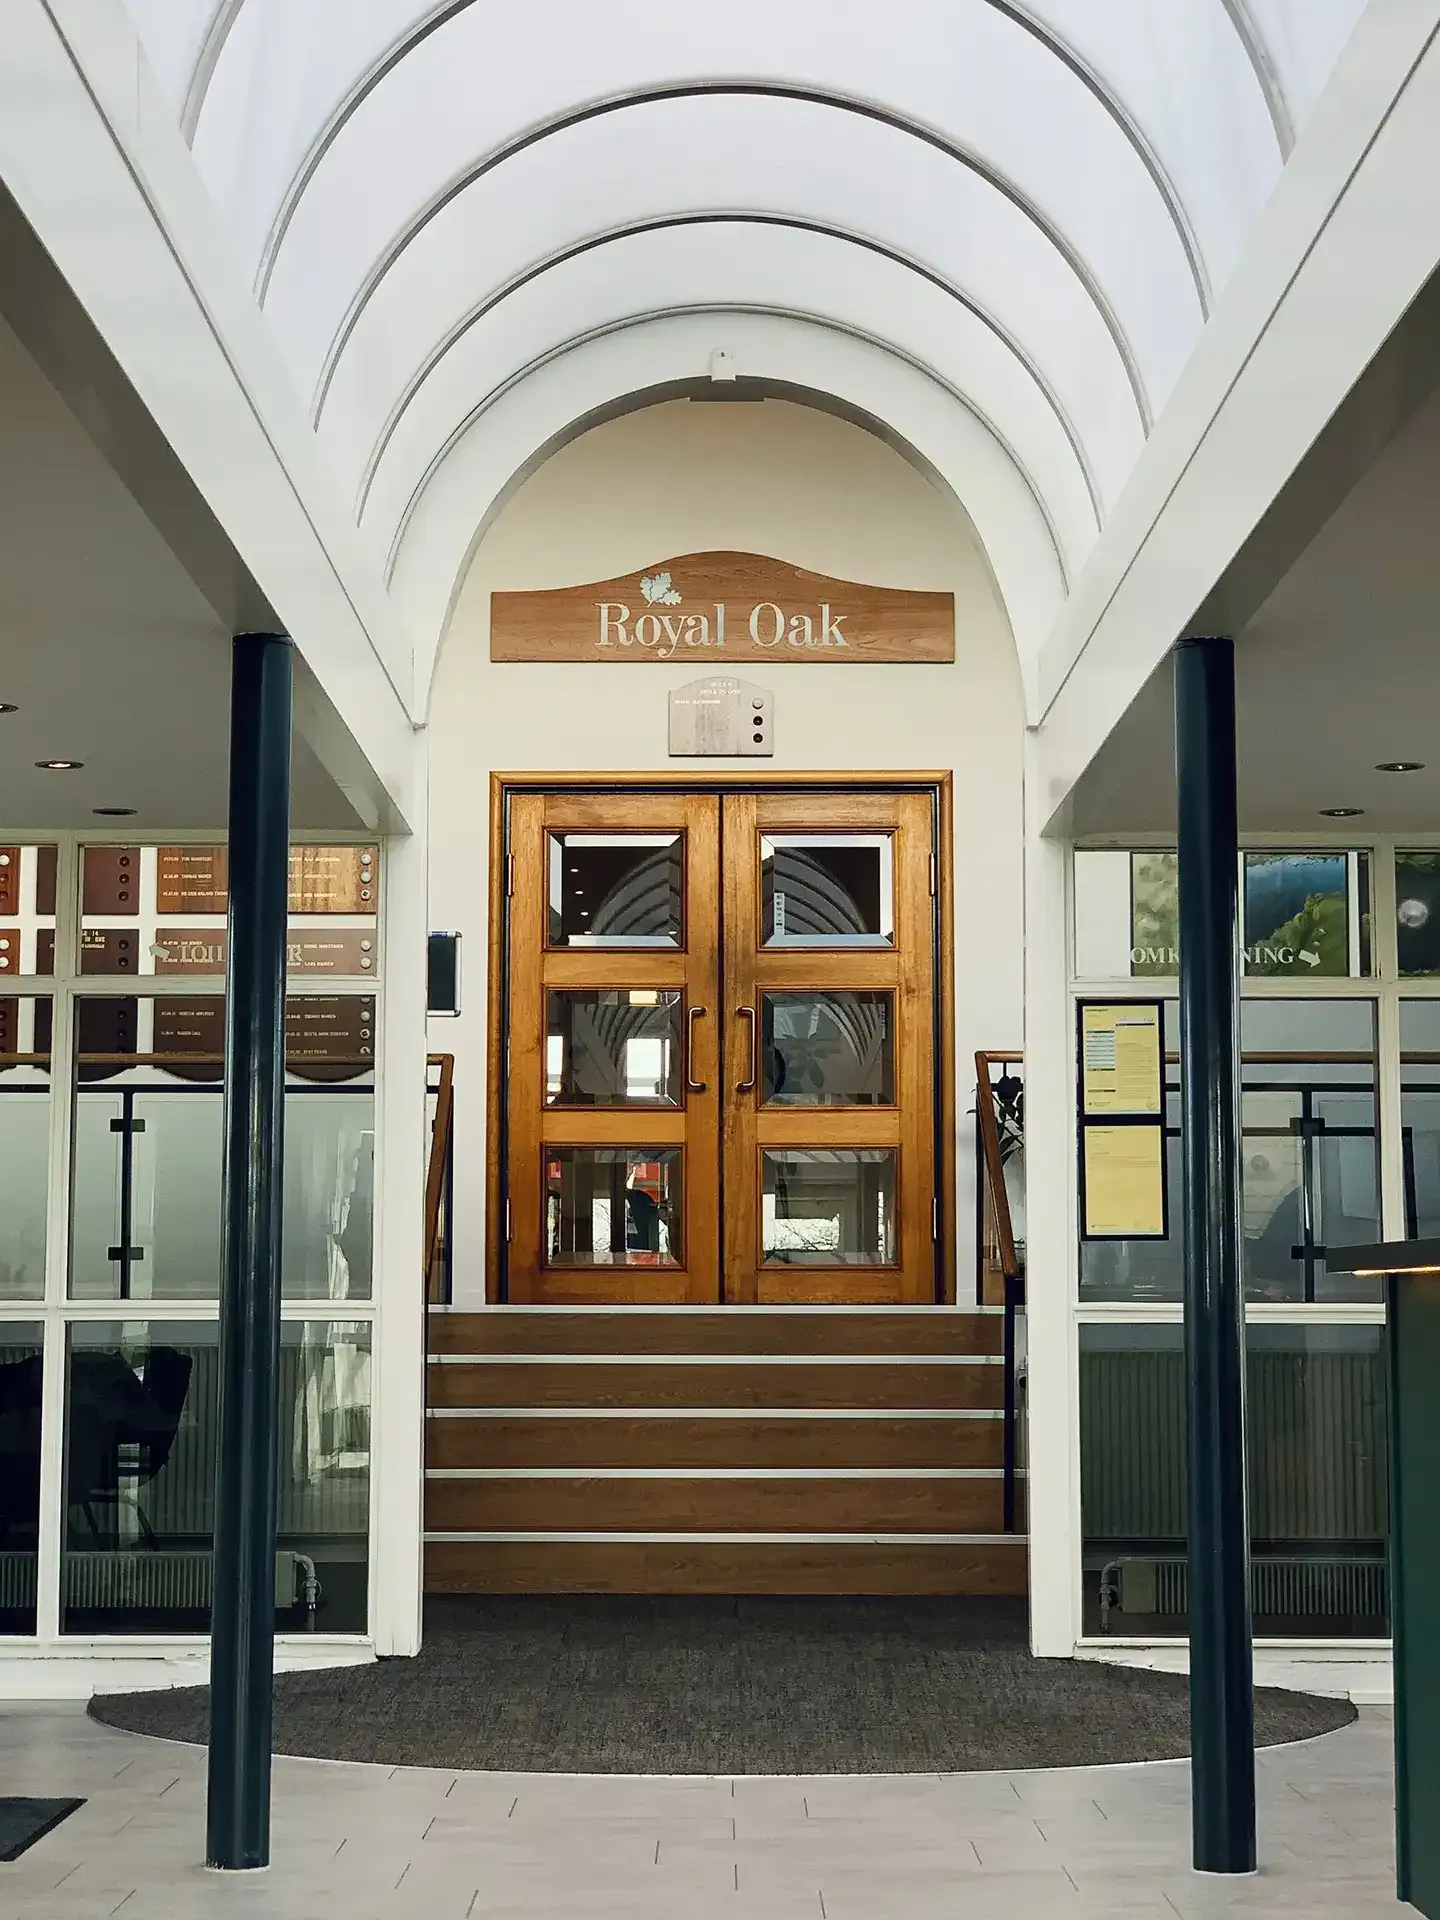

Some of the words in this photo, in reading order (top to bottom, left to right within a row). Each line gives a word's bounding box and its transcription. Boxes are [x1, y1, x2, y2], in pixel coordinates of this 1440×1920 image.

[594, 603, 725, 658] Royal
[749, 602, 850, 648] Oak
[1130, 946, 1294, 964] OMKNING
